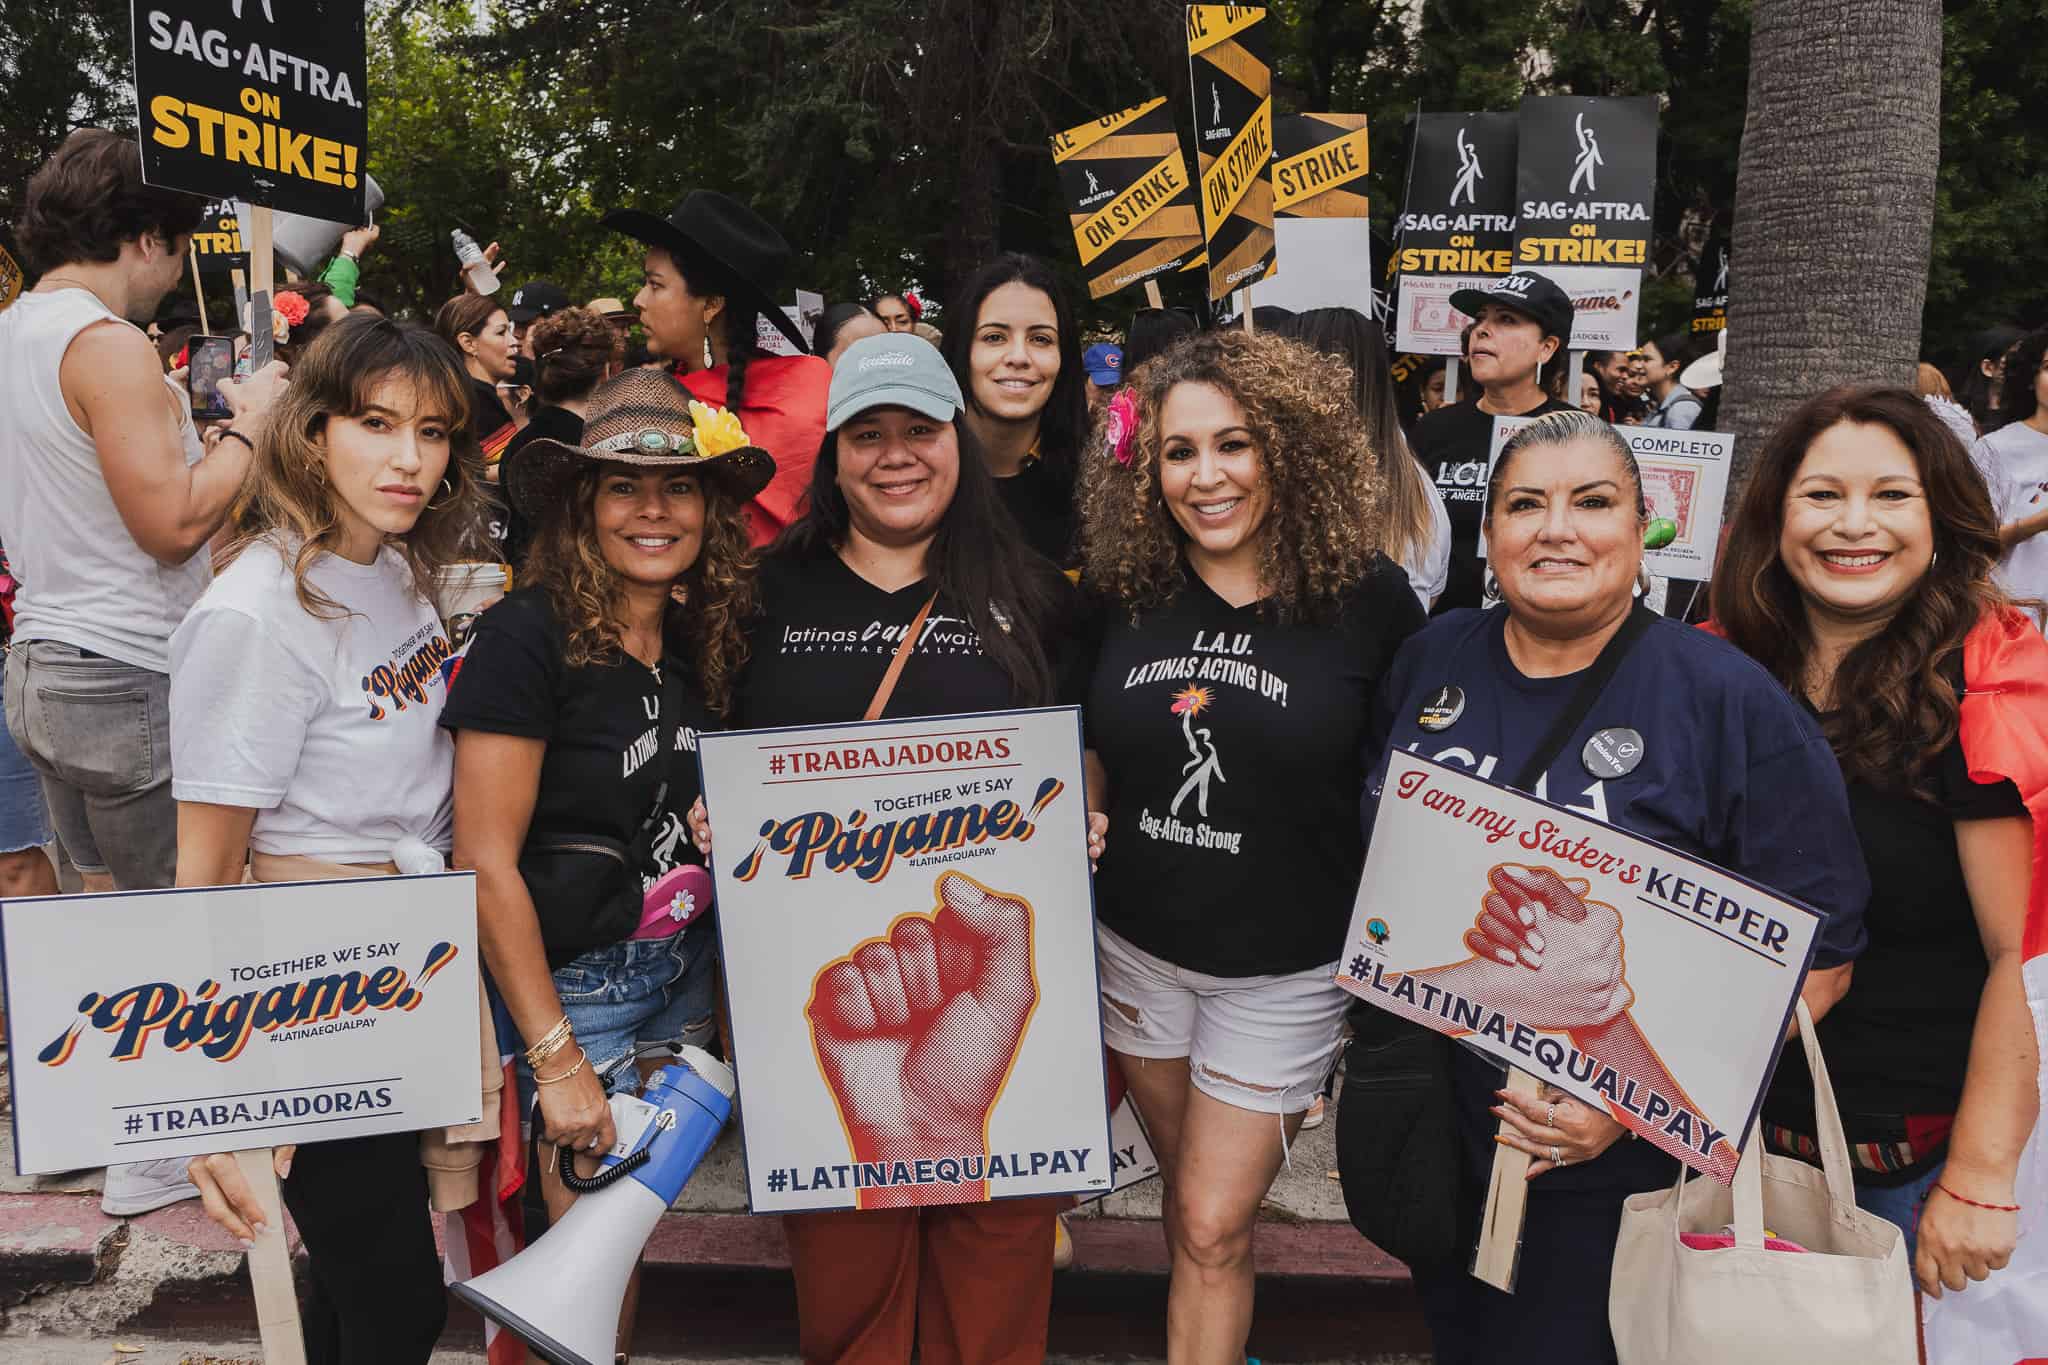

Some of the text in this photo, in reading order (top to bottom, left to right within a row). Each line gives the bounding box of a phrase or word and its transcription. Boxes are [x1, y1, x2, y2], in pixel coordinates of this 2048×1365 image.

[240, 87, 281, 120] ON
[150, 95, 358, 189] STRIKE!
[1209, 115, 1268, 217] ON STRIKE
[1278, 142, 1360, 196] STRIKE
[1085, 216, 1116, 248] ON
[1112, 166, 1179, 226] STRIKE
[1449, 235, 1475, 248] ON
[1570, 223, 1597, 237] ON
[1519, 237, 1646, 264] STRIKE!
[1631, 436, 1724, 457] COMPLETO
[1436, 461, 1488, 487] LCL
[1450, 491, 1485, 501] ANGEL
[783, 625, 857, 644] latinas
[1192, 630, 1254, 655] L.A.U.
[1124, 656, 1289, 708] LATINAS ACTING UP!
[769, 738, 1011, 775] #TRABAJADORAS
[874, 778, 1014, 812] TOGETHER WE SAY
[1139, 807, 1242, 854] Sag-Aftra Strong
[909, 847, 997, 868] #LATINAEQUALPAY
[1397, 770, 1429, 799] I
[1422, 785, 1466, 818] am
[1466, 805, 1516, 844] my
[1518, 819, 1642, 884] Sister's
[1644, 866, 1789, 953] KEEPER
[230, 942, 401, 982] TOGETHER WE SAY
[269, 1017, 377, 1044] #LATINAEQUALPAY
[1348, 953, 1728, 1157] #LATINAEQUALPAY
[123, 1087, 393, 1135] #TRABAJADORAS
[767, 1148, 1092, 1193] #LATINAEQUALPAY
